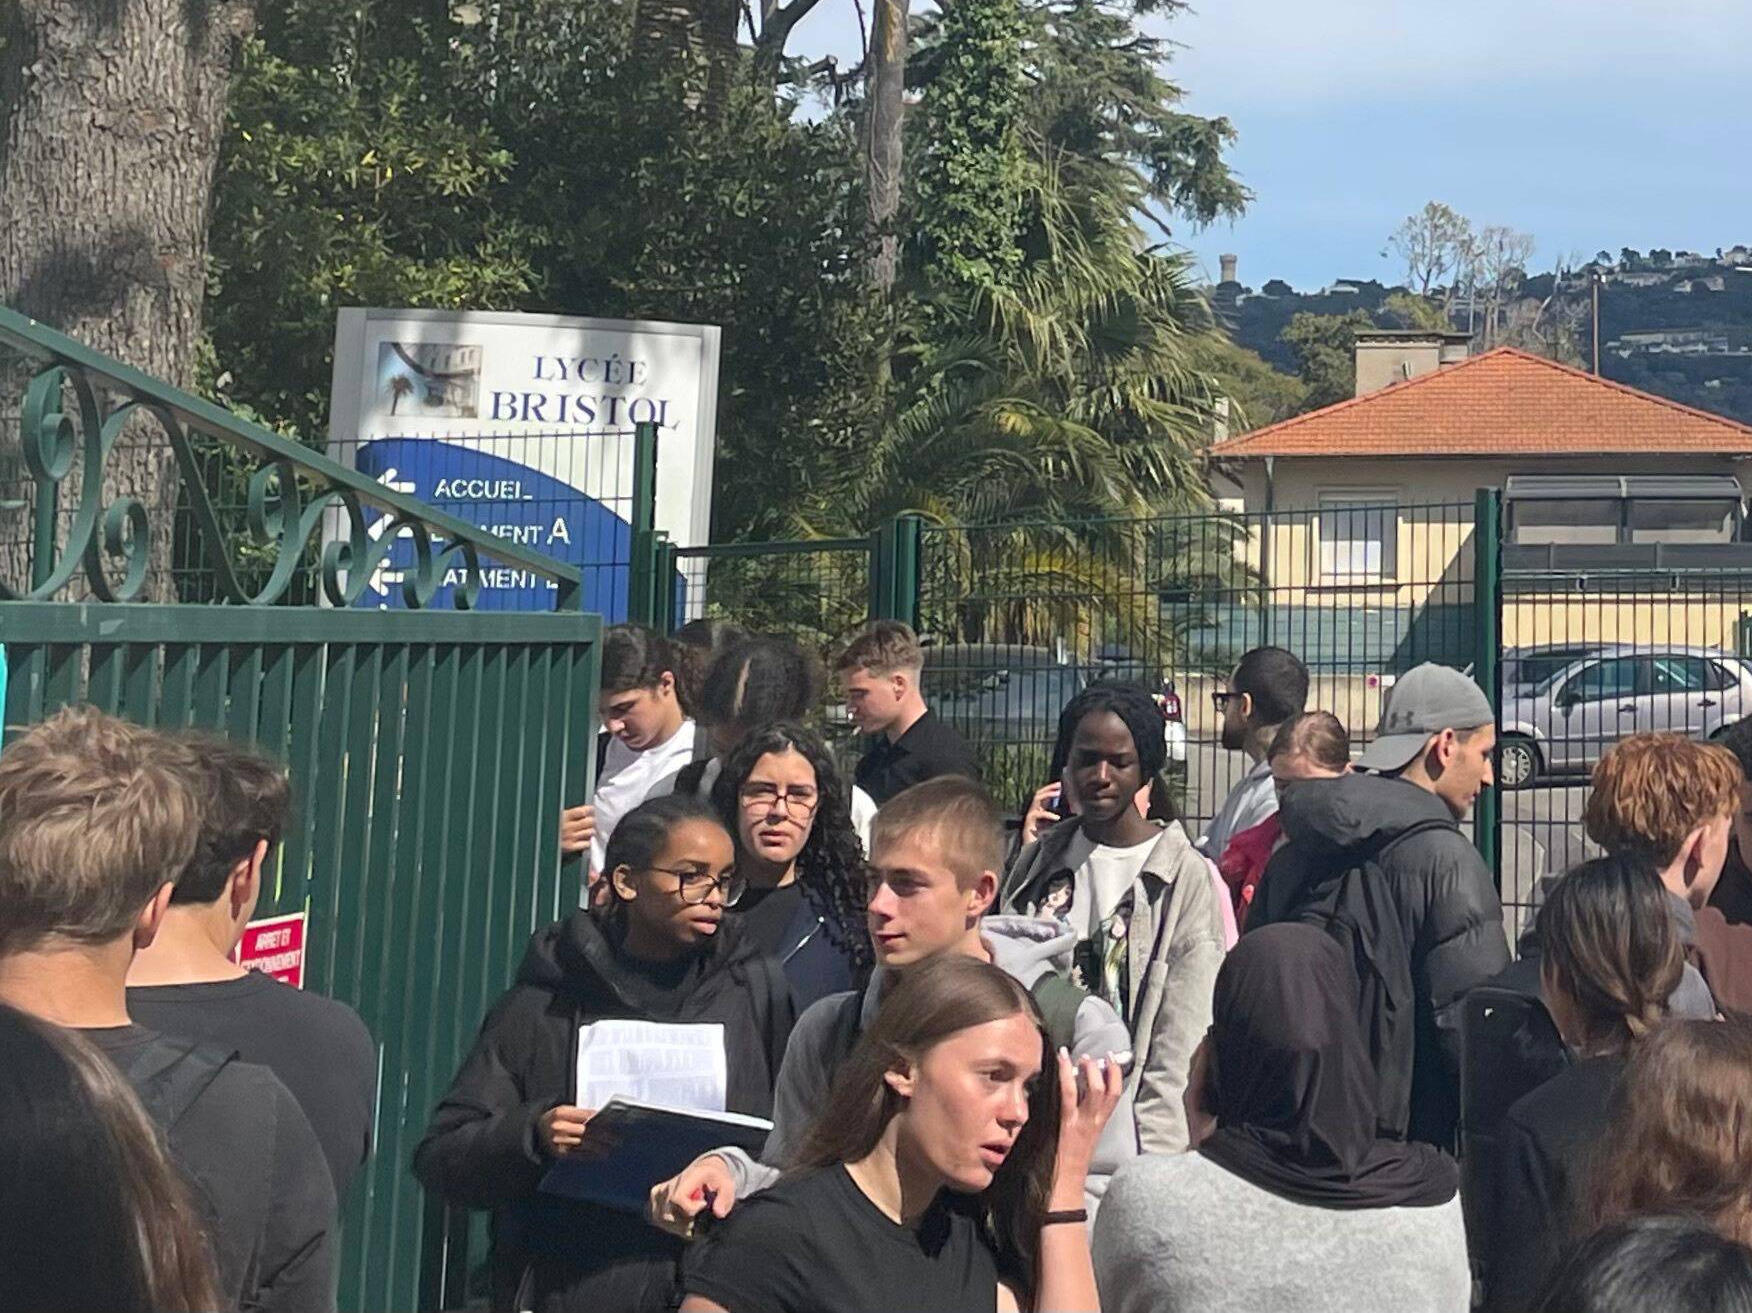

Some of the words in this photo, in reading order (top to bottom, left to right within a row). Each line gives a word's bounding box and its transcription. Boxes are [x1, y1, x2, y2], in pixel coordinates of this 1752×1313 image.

[533, 353, 648, 385] LYCÉE
[490, 390, 680, 430] BRISTOL
[547, 517, 571, 545] A
